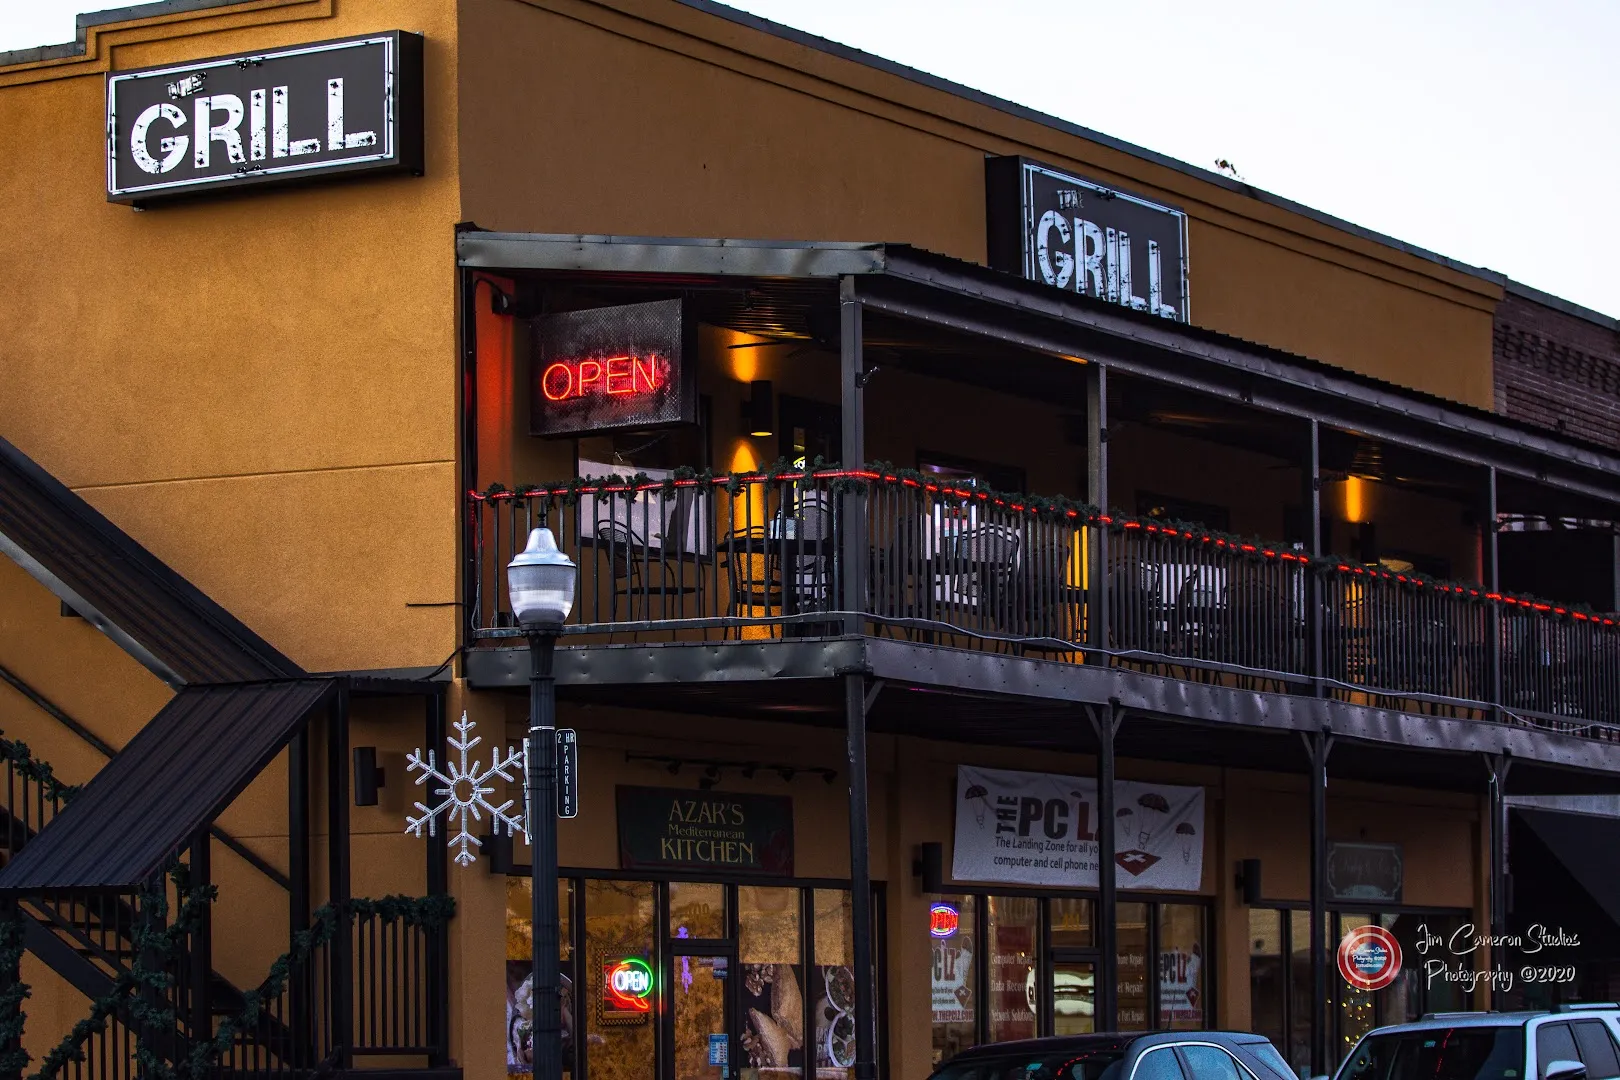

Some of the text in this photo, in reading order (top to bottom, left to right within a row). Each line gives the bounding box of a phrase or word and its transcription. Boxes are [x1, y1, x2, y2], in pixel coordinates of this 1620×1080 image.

[130, 77, 377, 174] GRILL
[1037, 210, 1178, 321] GRILL
[542, 354, 656, 400] OPEN
[557, 733, 575, 744] 2 HR
[668, 799, 744, 826] AZAR'S
[996, 796, 1018, 834] THE
[1018, 796, 1100, 841] PC L
[668, 823, 745, 840] Mediterranean
[661, 837, 754, 863] KITCHEN
[995, 836, 1099, 856] The Landing Zone for all yo
[993, 856, 1033, 868] computer
[1033, 857, 1049, 868] and
[1049, 858, 1064, 869] cell
[1064, 859, 1088, 872] phone
[615, 970, 649, 991] OPEN
